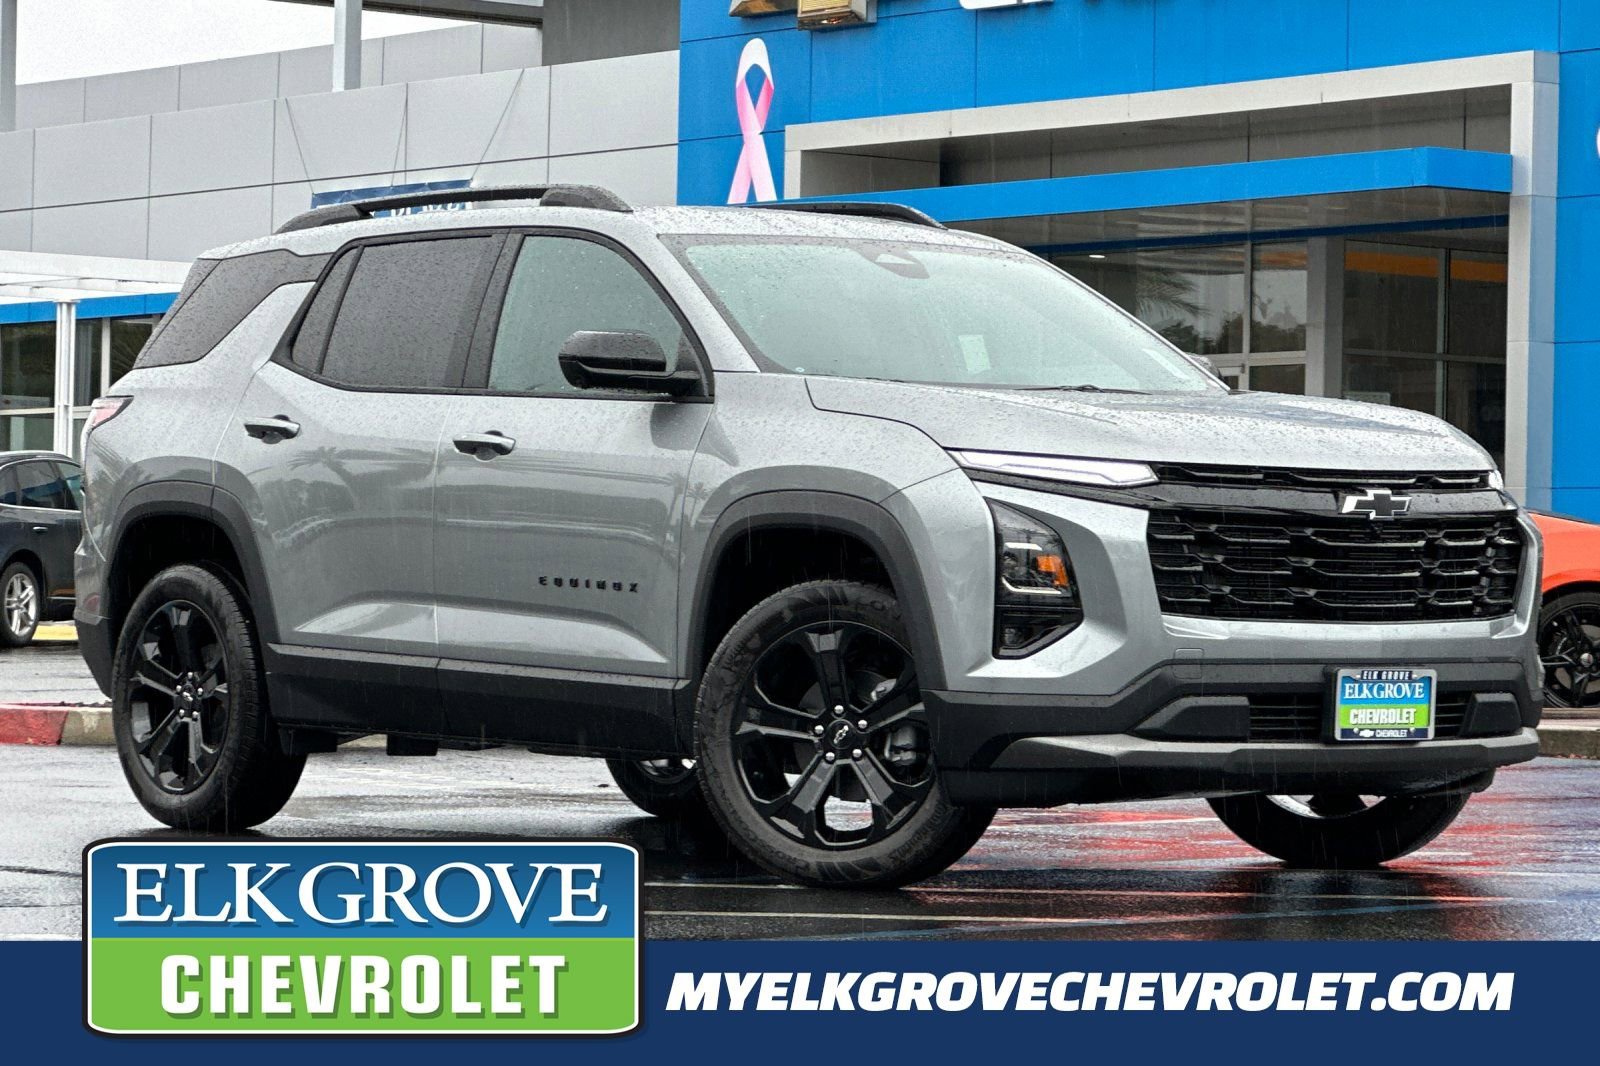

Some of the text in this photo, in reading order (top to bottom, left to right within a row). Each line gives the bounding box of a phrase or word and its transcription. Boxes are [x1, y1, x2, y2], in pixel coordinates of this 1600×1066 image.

[538, 576, 639, 593] EQUINOX
[1363, 671, 1410, 680] ELK GROVE
[1350, 708, 1416, 725] CHEVROLET
[1375, 729, 1407, 738] CHEVROLET
